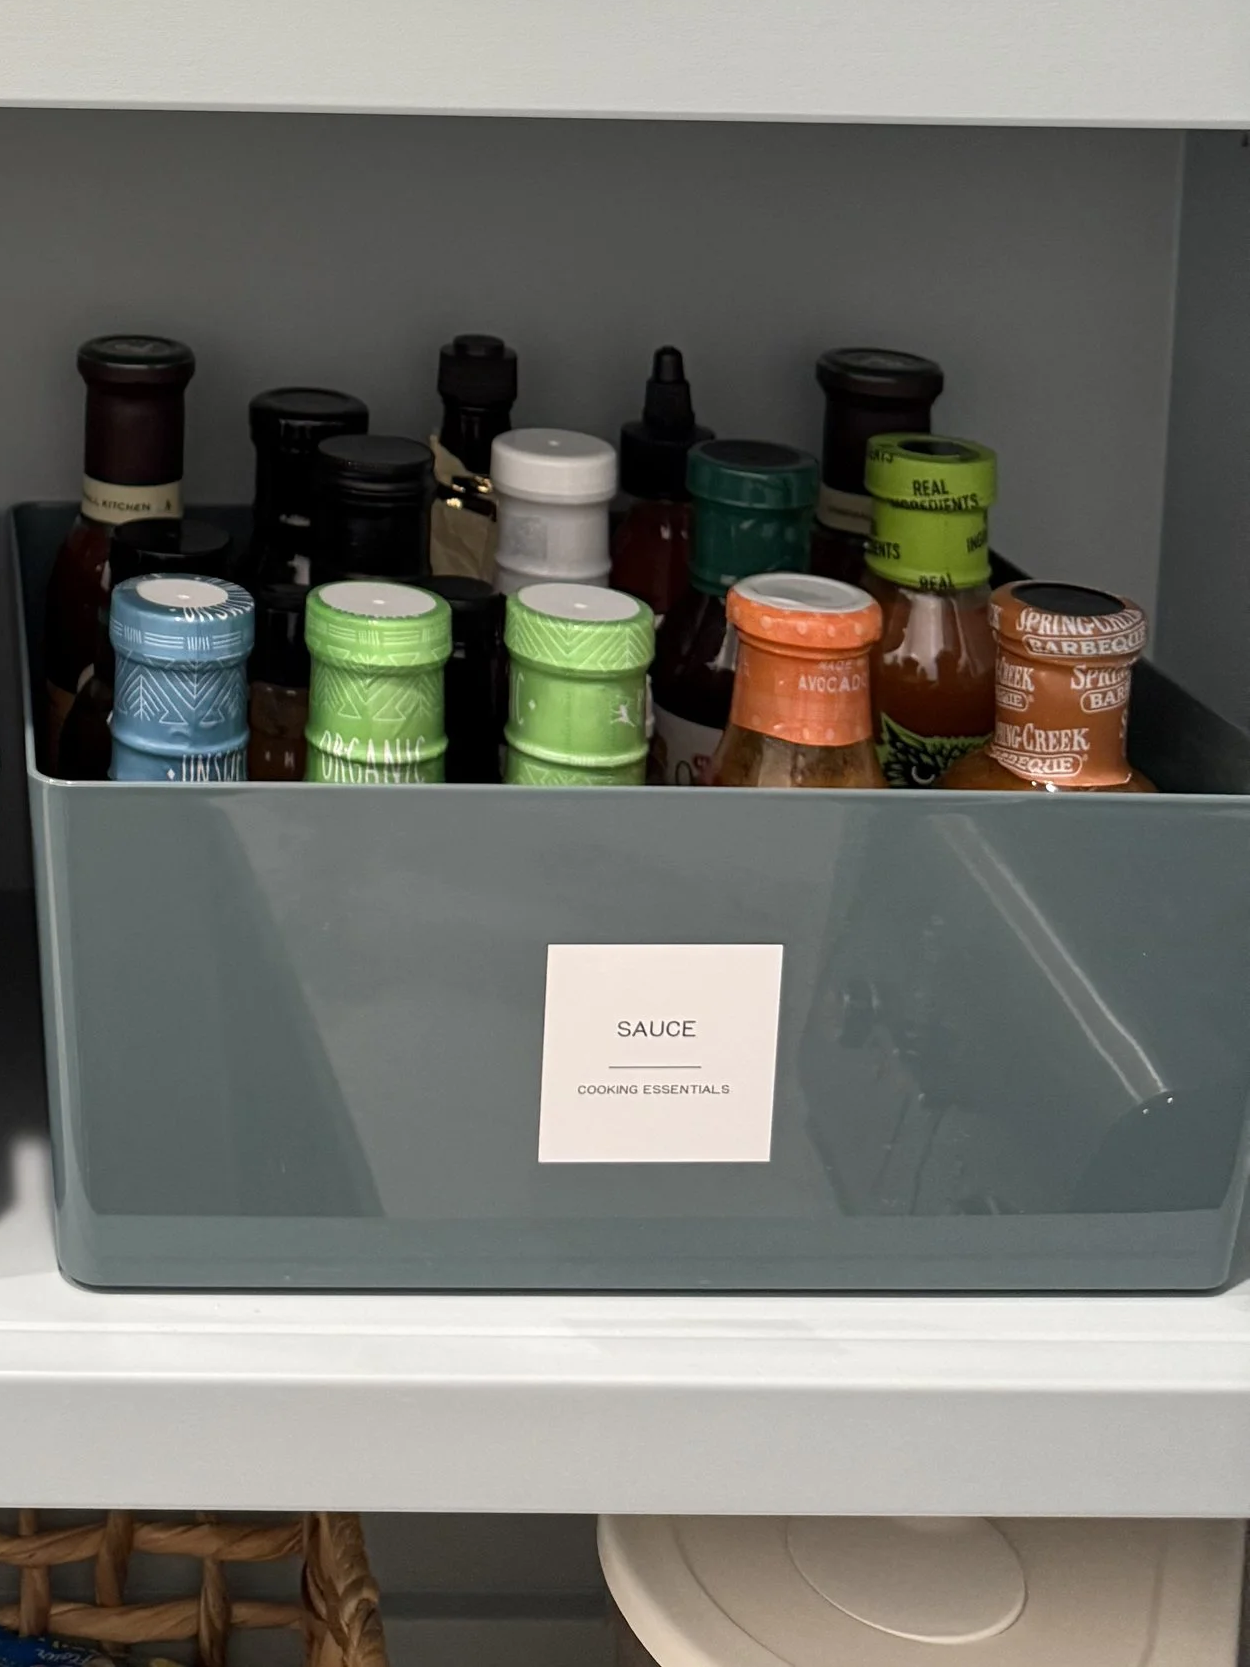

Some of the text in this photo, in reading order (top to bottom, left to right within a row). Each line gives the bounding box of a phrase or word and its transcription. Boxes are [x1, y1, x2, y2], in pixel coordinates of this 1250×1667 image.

[912, 479, 949, 497] REAL
[319, 730, 426, 784] ORGANIC
[617, 1020, 697, 1037] SAUCE
[577, 1084, 730, 1095] COOKING ESSENTIALS
